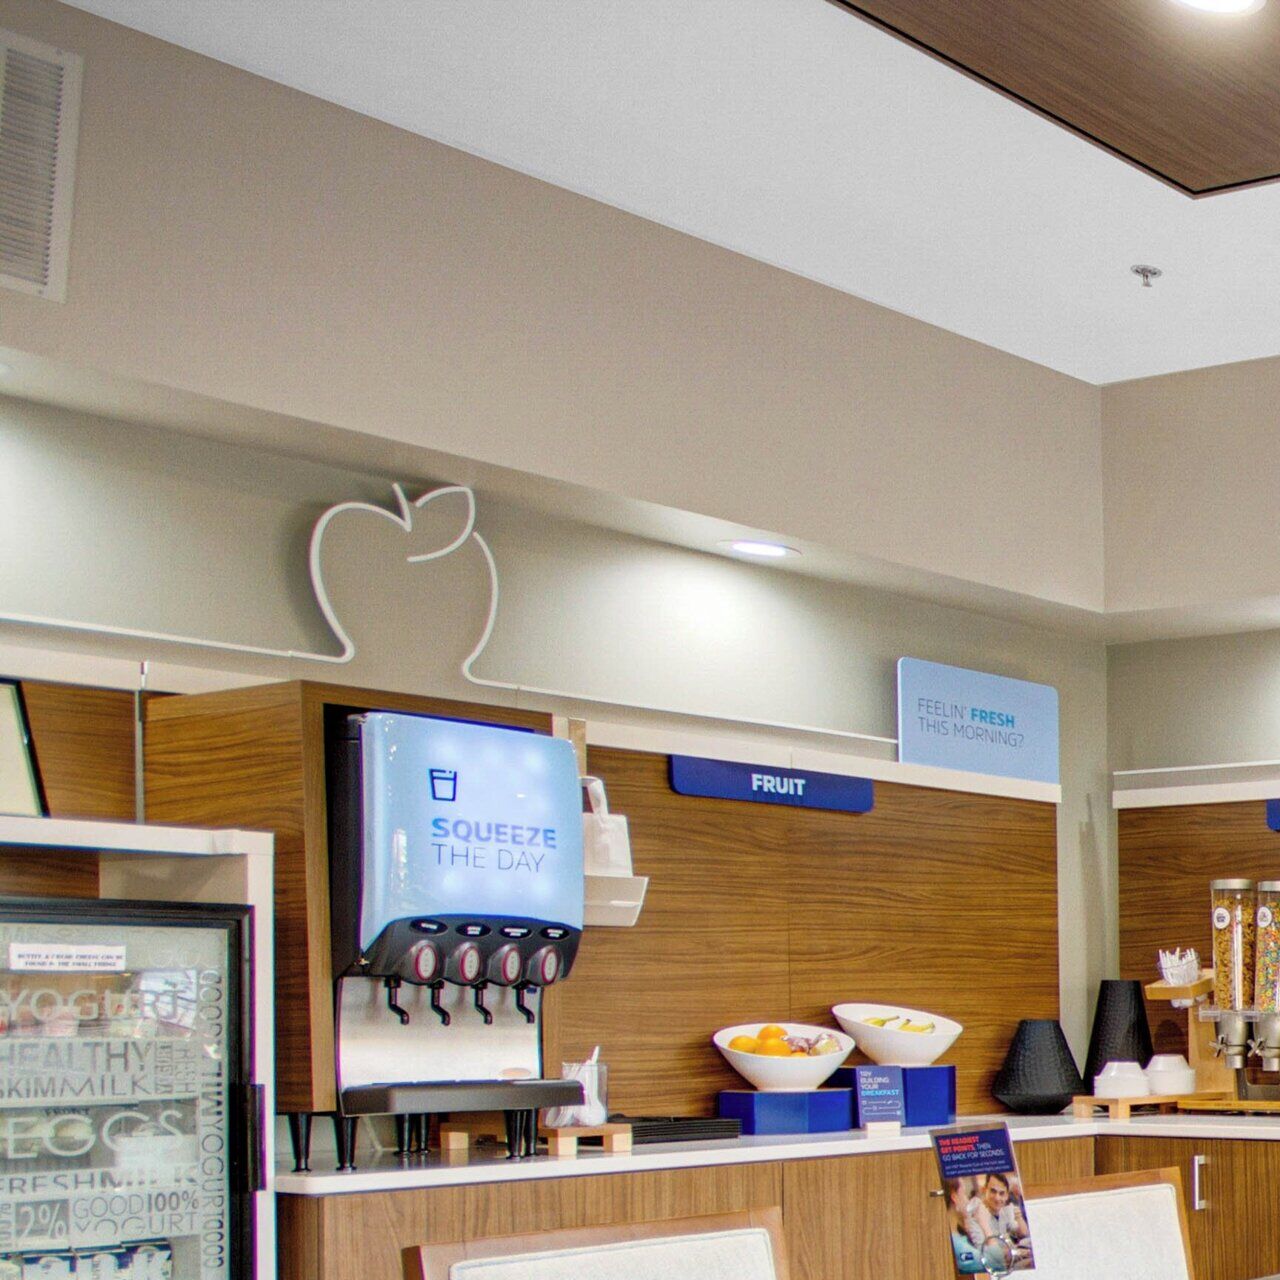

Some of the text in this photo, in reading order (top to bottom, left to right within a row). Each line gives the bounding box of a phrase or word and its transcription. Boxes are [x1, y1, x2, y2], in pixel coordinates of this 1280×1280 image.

[918, 716, 1025, 748] THIS MORNING?
[970, 708, 1015, 729] FRESH
[751, 773, 806, 795] FRUIT
[432, 817, 557, 850] SQUEEZE
[431, 842, 545, 873] THE DAY
